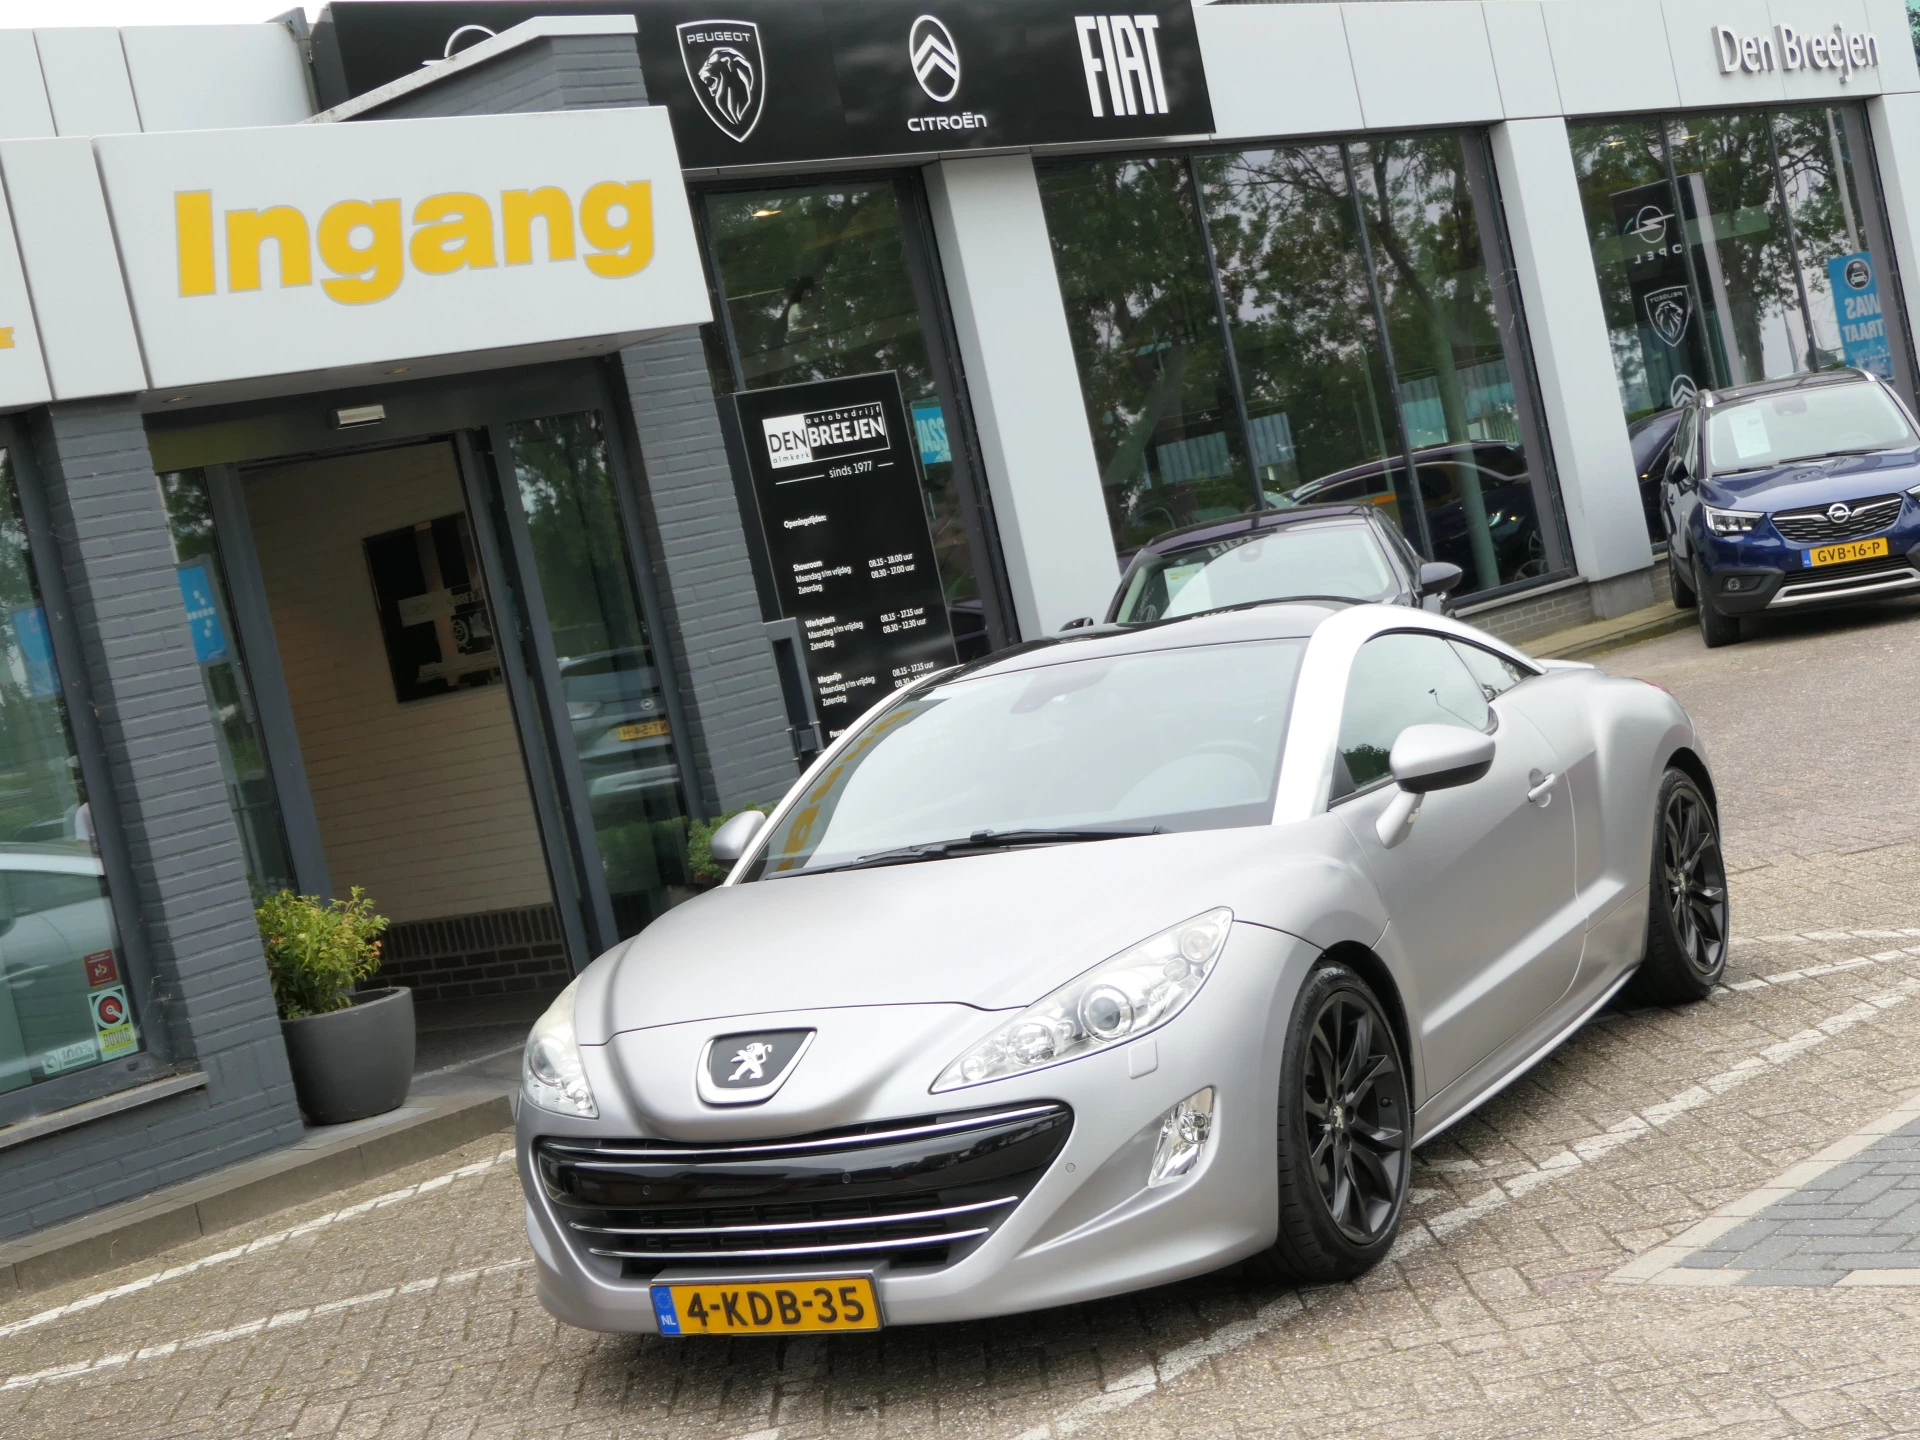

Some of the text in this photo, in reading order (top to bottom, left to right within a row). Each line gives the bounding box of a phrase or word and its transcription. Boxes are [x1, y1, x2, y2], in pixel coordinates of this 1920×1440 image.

[686, 30, 752, 46] PEUGEOT
[1713, 22, 1880, 84] Den Breejen
[1074, 14, 1169, 118] FIAT
[173, 179, 657, 306] Ingang
[806, 405, 881, 424] autobedrijf
[768, 416, 886, 454] DEN BREEJEN
[773, 451, 810, 464] almkerk
[828, 461, 873, 479] sinds 1977
[903, 552, 913, 561] uur
[1818, 542, 1880, 562] GVB-16-P
[793, 560, 823, 573] Showroom
[795, 571, 822, 584] Maandag
[832, 565, 852, 576] vrijdag
[905, 563, 915, 572] uur
[798, 583, 823, 595] Zaterdag
[914, 607, 924, 616] uur
[805, 615, 836, 629] Werkplaats
[917, 618, 927, 626] uur
[808, 628, 834, 640] Maandag
[844, 621, 864, 632] vrijdag
[810, 639, 835, 651] Zaterdag
[924, 661, 934, 669] uur
[817, 672, 842, 684] Magazijn
[820, 684, 845, 695] Maandag
[856, 676, 876, 687] vrijdag
[822, 694, 847, 707] Zaterdag
[103, 1028, 131, 1048] BOVAG
[61, 1044, 92, 1060] 100%
[661, 1286, 865, 1327] NL 4-KDB-35
